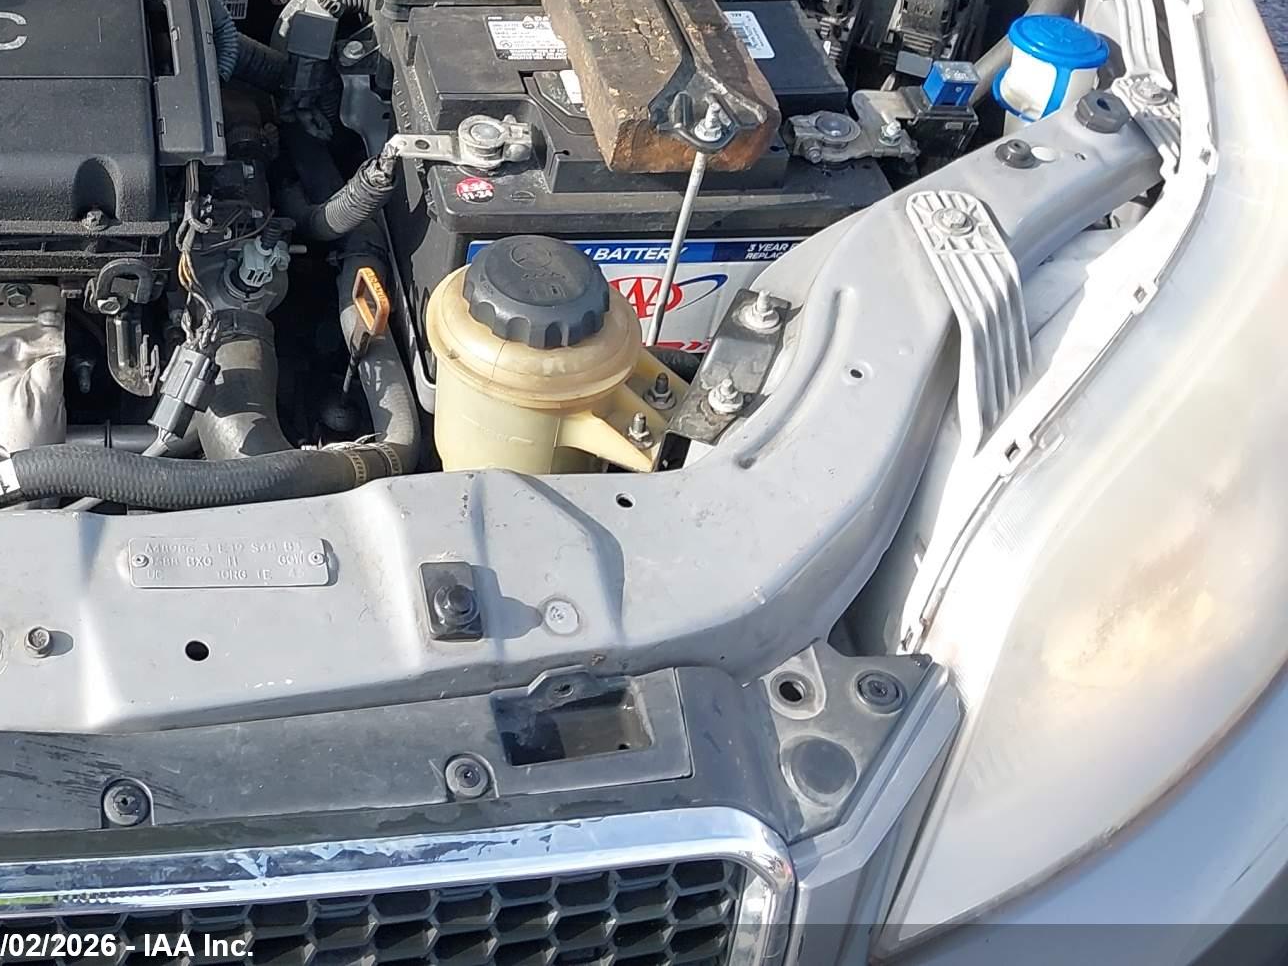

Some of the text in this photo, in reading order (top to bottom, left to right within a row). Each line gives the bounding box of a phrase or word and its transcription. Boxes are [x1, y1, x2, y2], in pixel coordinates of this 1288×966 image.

[593, 246, 688, 262] BATTER
[746, 243, 756, 253] 3
[758, 243, 789, 253] YEAR
